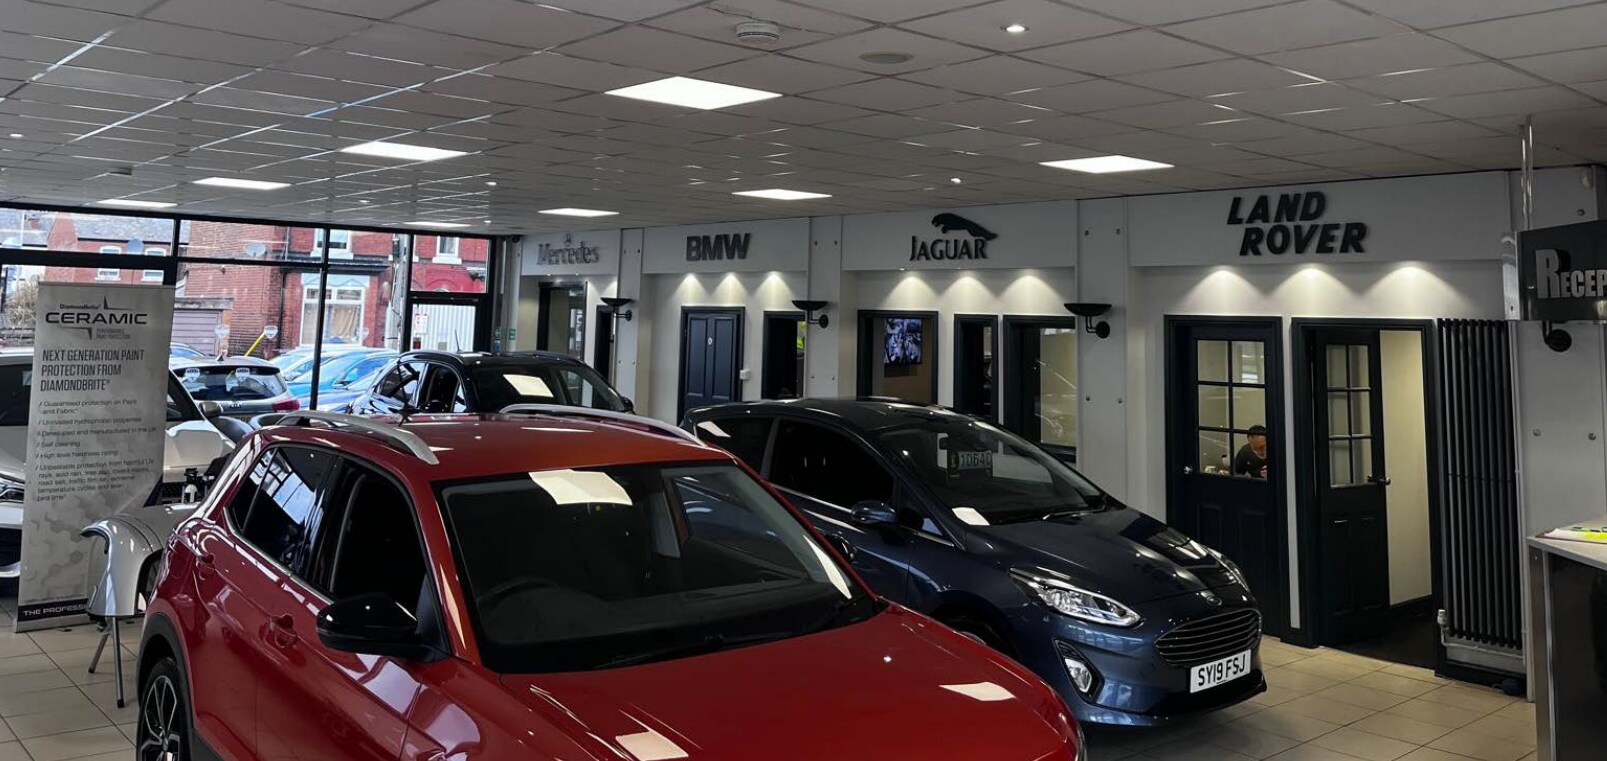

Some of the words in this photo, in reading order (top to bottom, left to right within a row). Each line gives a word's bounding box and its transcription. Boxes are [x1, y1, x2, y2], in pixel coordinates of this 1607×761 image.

[1227, 191, 1327, 225] LAND
[686, 233, 752, 261] BMW
[909, 235, 989, 261] JAGUAR
[1239, 222, 1369, 256] ROVER
[536, 240, 600, 265] Mercedes
[45, 312, 148, 325] CERAMIC
[42, 350, 65, 361] NEXT
[67, 349, 119, 361] GENERATION
[120, 349, 145, 361] PAINT
[41, 364, 96, 376] PROTECTION
[97, 364, 122, 376] FROM
[1198, 662, 1224, 687] SY19
[1225, 654, 1247, 679] FSJ
